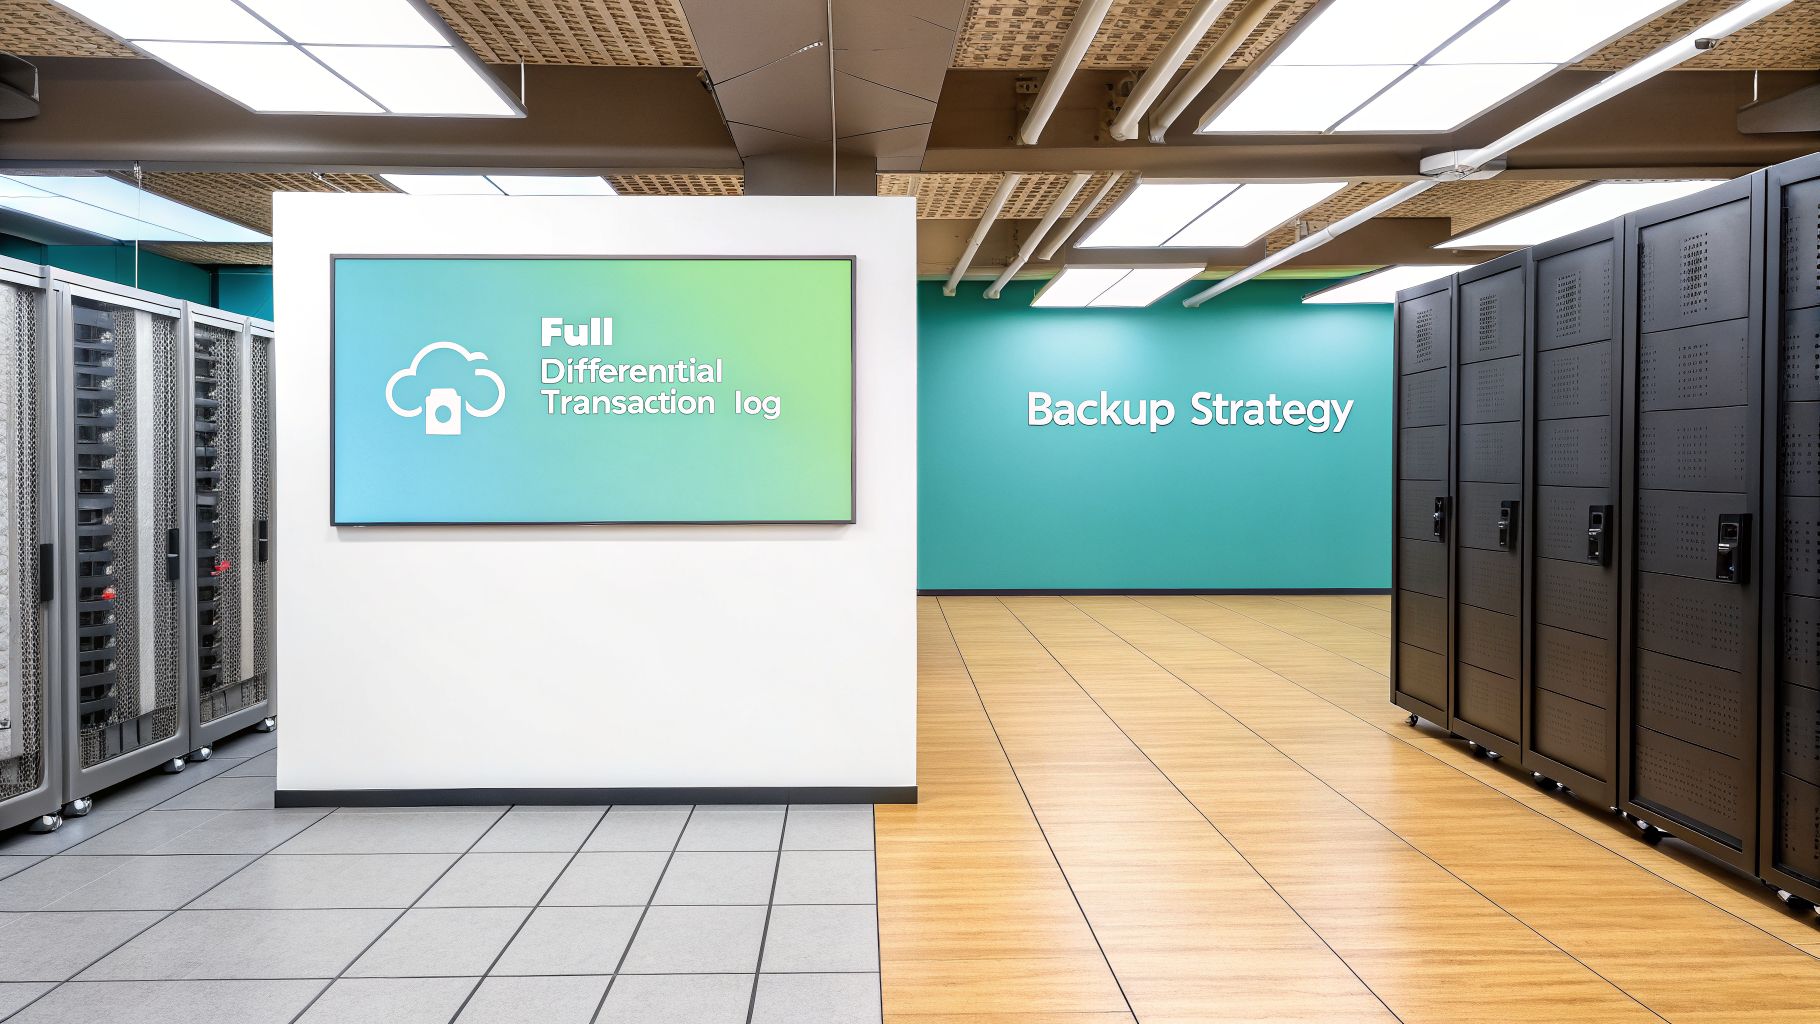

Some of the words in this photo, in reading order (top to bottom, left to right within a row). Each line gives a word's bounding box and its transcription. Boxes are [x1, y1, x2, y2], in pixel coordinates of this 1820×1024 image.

[541, 317, 613, 347] Full
[541, 388, 715, 415] Transaction
[735, 390, 781, 420] log
[1028, 390, 1175, 433] Backup
[1191, 391, 1354, 433] Strategy
